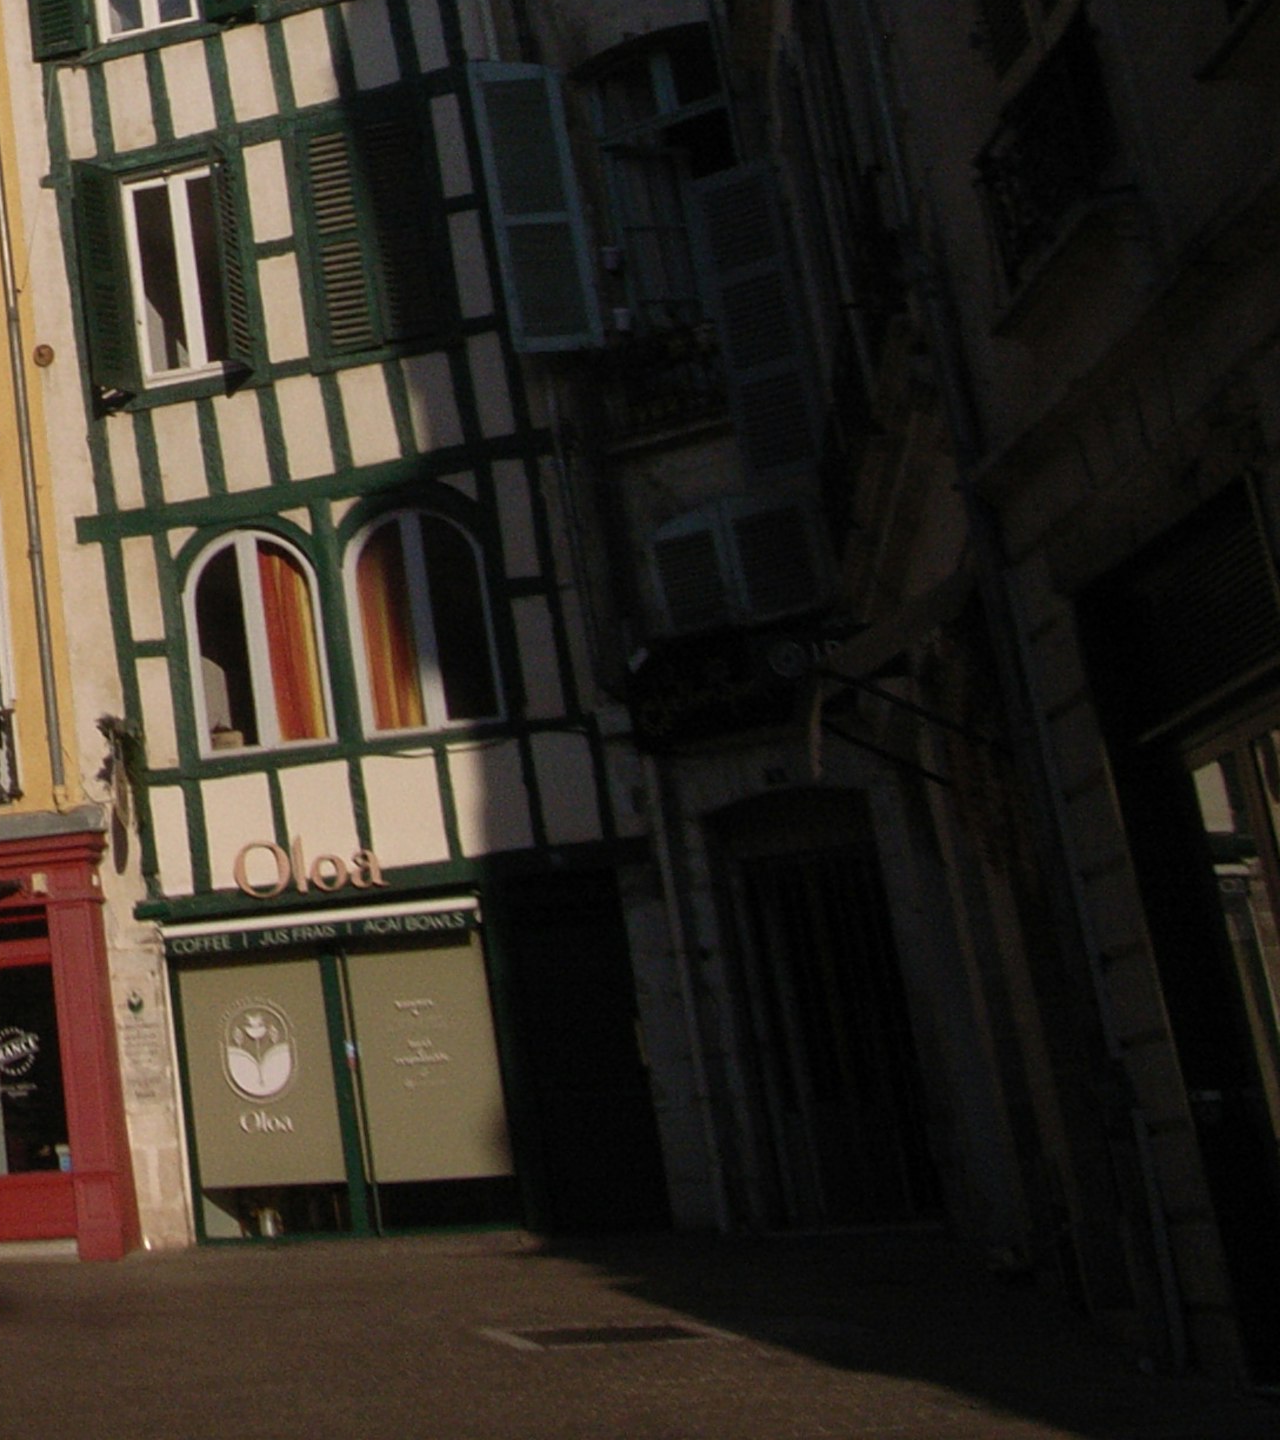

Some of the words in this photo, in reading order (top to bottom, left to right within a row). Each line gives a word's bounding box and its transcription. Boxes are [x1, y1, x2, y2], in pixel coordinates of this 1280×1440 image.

[233, 834, 390, 900] Oloa
[171, 933, 232, 955] COFFEE
[259, 928, 290, 947] JUS
[291, 923, 337, 942] FRAIS
[403, 910, 466, 932] BOWLS
[239, 1110, 295, 1134] Oloa
